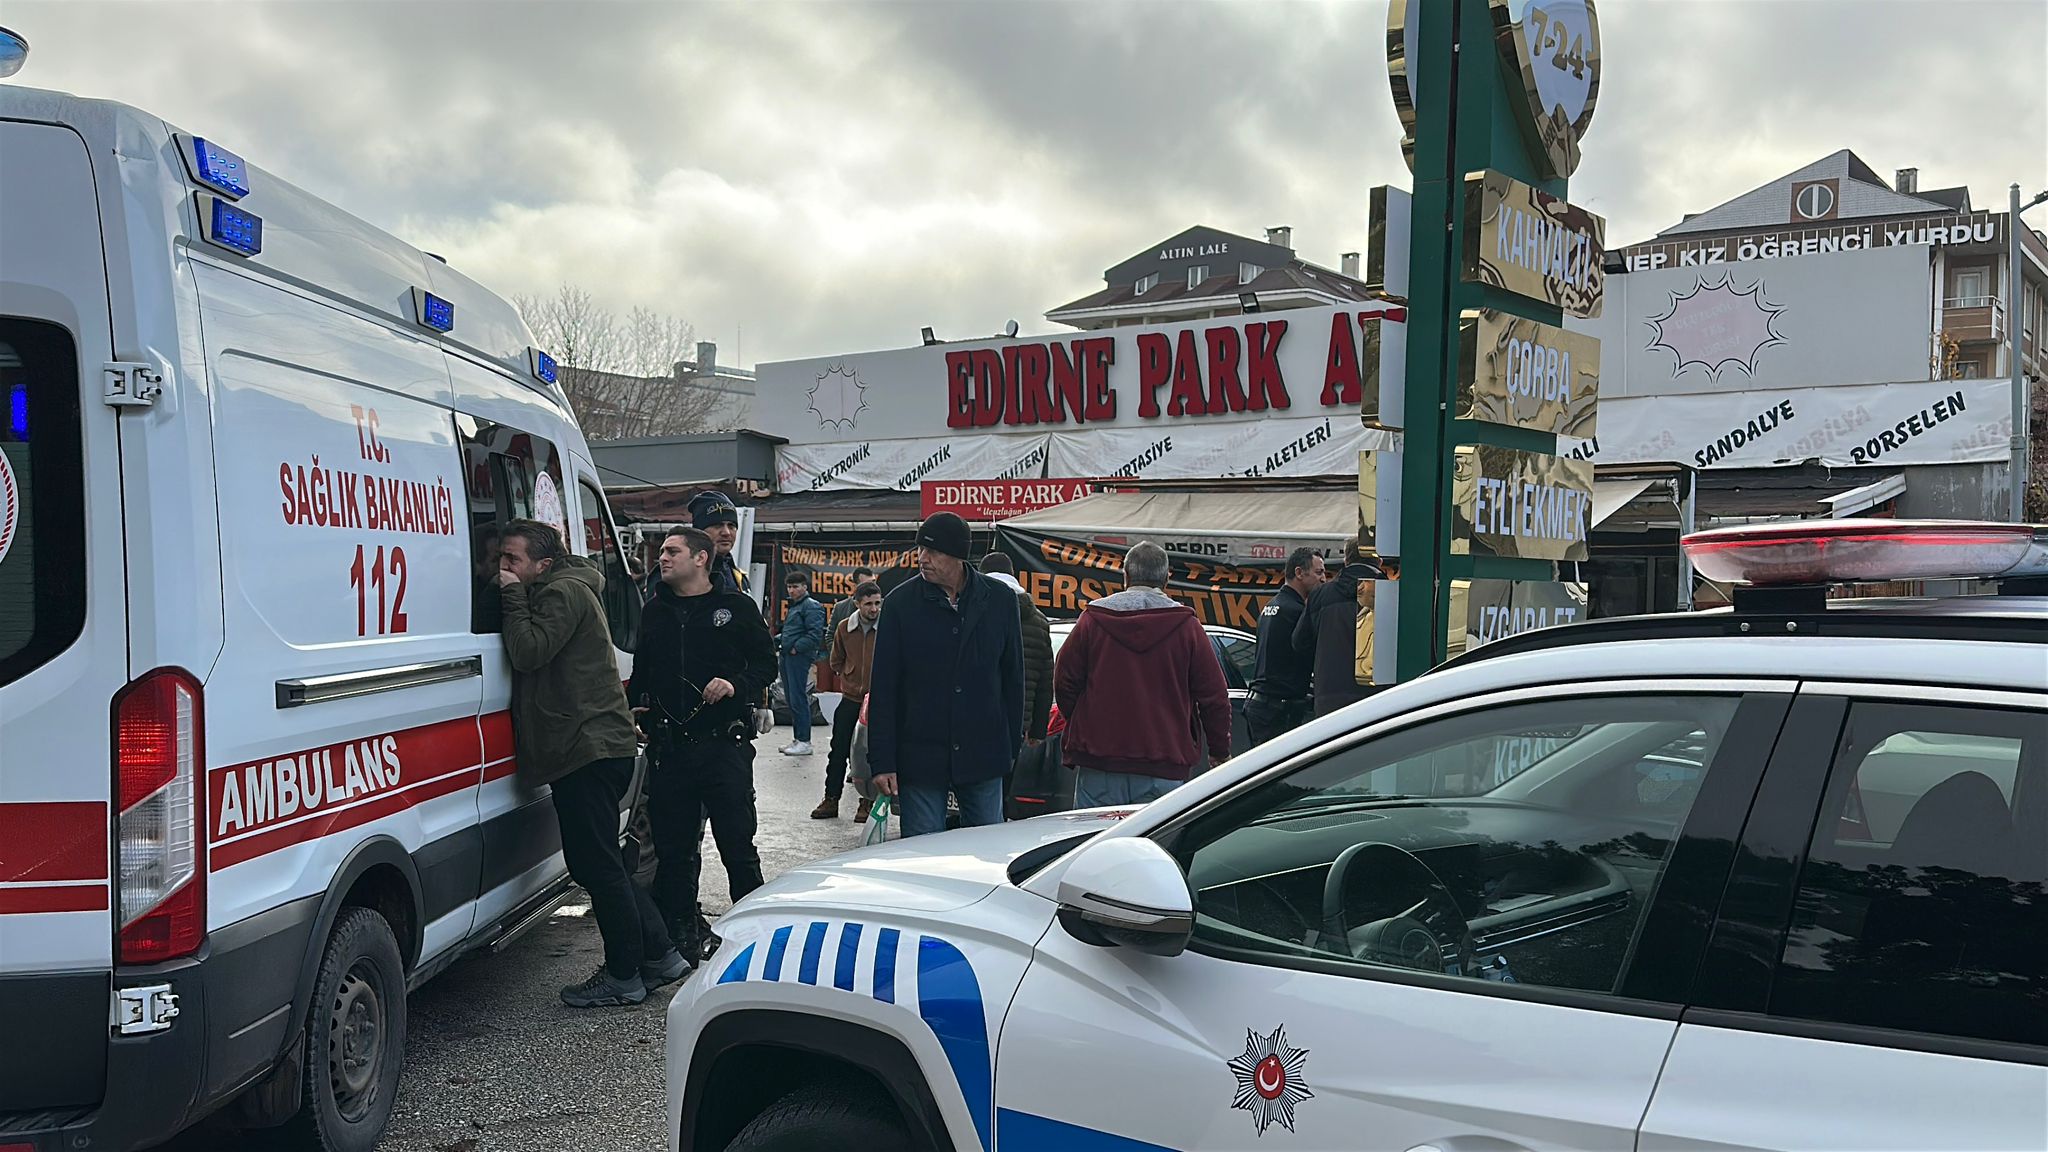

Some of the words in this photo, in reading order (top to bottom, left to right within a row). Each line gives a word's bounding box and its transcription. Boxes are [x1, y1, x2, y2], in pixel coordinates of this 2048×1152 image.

[1531, 7, 1584, 80] 7-24
[1160, 247, 1194, 260] ALTIN
[1200, 243, 1228, 256] LALE
[1497, 203, 1592, 292] KAHVALTI
[1680, 247, 1725, 267] KIZ
[1738, 227, 1871, 262] ÖĞRENCİ
[1885, 222, 1995, 247] YURDU
[945, 336, 1117, 428] EDIRNE
[1137, 319, 1291, 418] PARK
[1506, 337, 1570, 404] ÇORBA
[351, 403, 391, 463] T.C.
[1265, 418, 1331, 474] ALETLERİ
[1694, 399, 1795, 467] SANDALYE
[1850, 391, 1966, 465] PORSELEN
[280, 454, 362, 529] SAĞLIK
[364, 474, 455, 535] BAKANLIĞI
[811, 443, 871, 490] ELEKTRONİK
[899, 444, 951, 490] KOZMATİK
[935, 482, 1003, 505] EDİRNE
[1010, 484, 1066, 504] PARK
[1475, 472, 1518, 536] ETLİ
[1522, 484, 1588, 541] EKMEK
[350, 544, 408, 637] 112
[830, 549, 864, 567] PARK
[868, 550, 898, 568] AVM
[218, 736, 401, 835] AMBULANS
